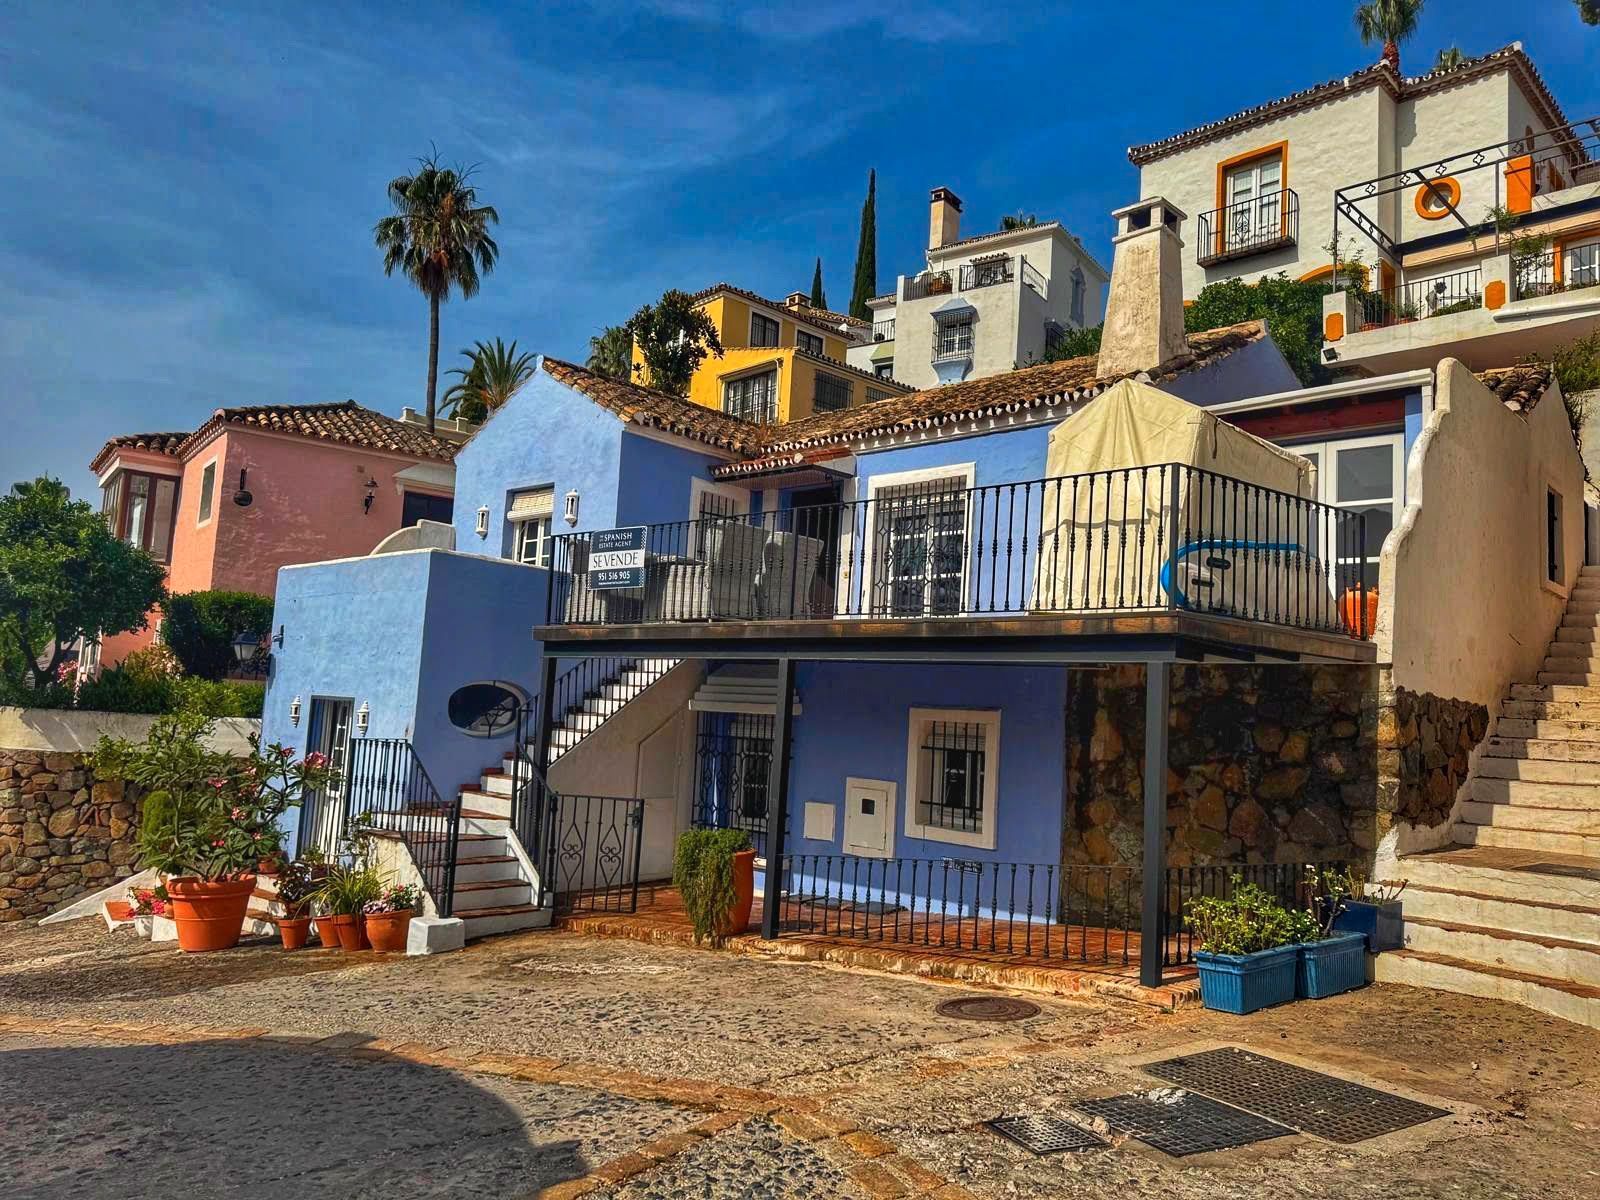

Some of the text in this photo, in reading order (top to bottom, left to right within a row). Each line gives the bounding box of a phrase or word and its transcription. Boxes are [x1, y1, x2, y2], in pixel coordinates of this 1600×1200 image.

[604, 532, 633, 541] SPANISH
[593, 552, 639, 569] SE VENDE
[598, 571, 631, 580] 951 516 905
